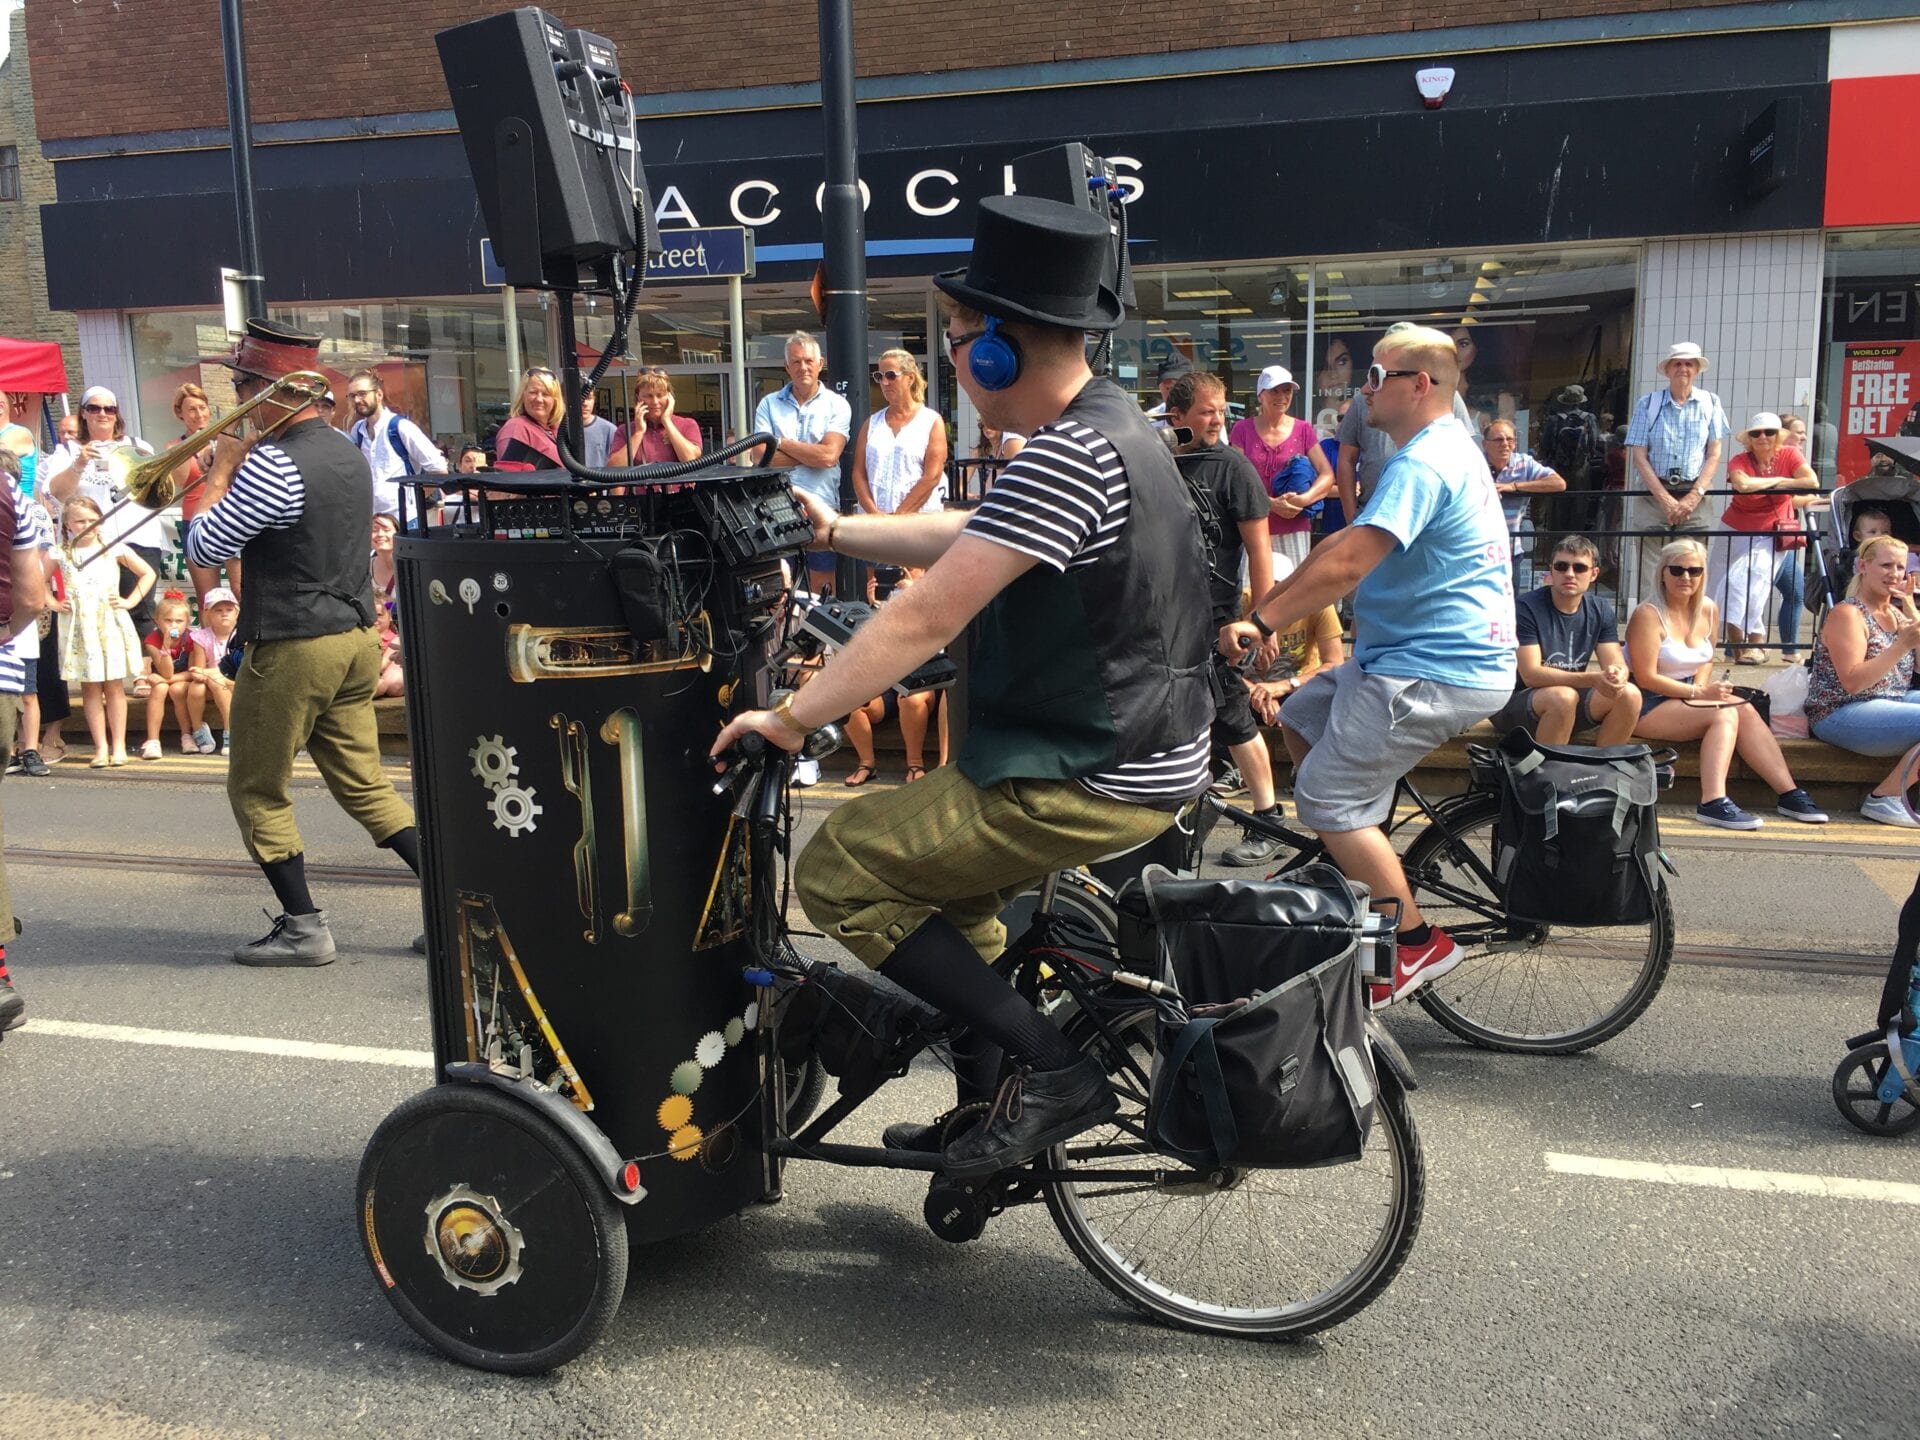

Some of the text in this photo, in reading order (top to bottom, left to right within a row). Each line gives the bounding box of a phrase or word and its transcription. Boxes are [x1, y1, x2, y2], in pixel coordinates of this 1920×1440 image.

[1422, 75, 1450, 83] KINGS
[631, 241, 706, 270] reet
[1852, 360, 1895, 371] BetStation
[1850, 372, 1911, 406] FREE
